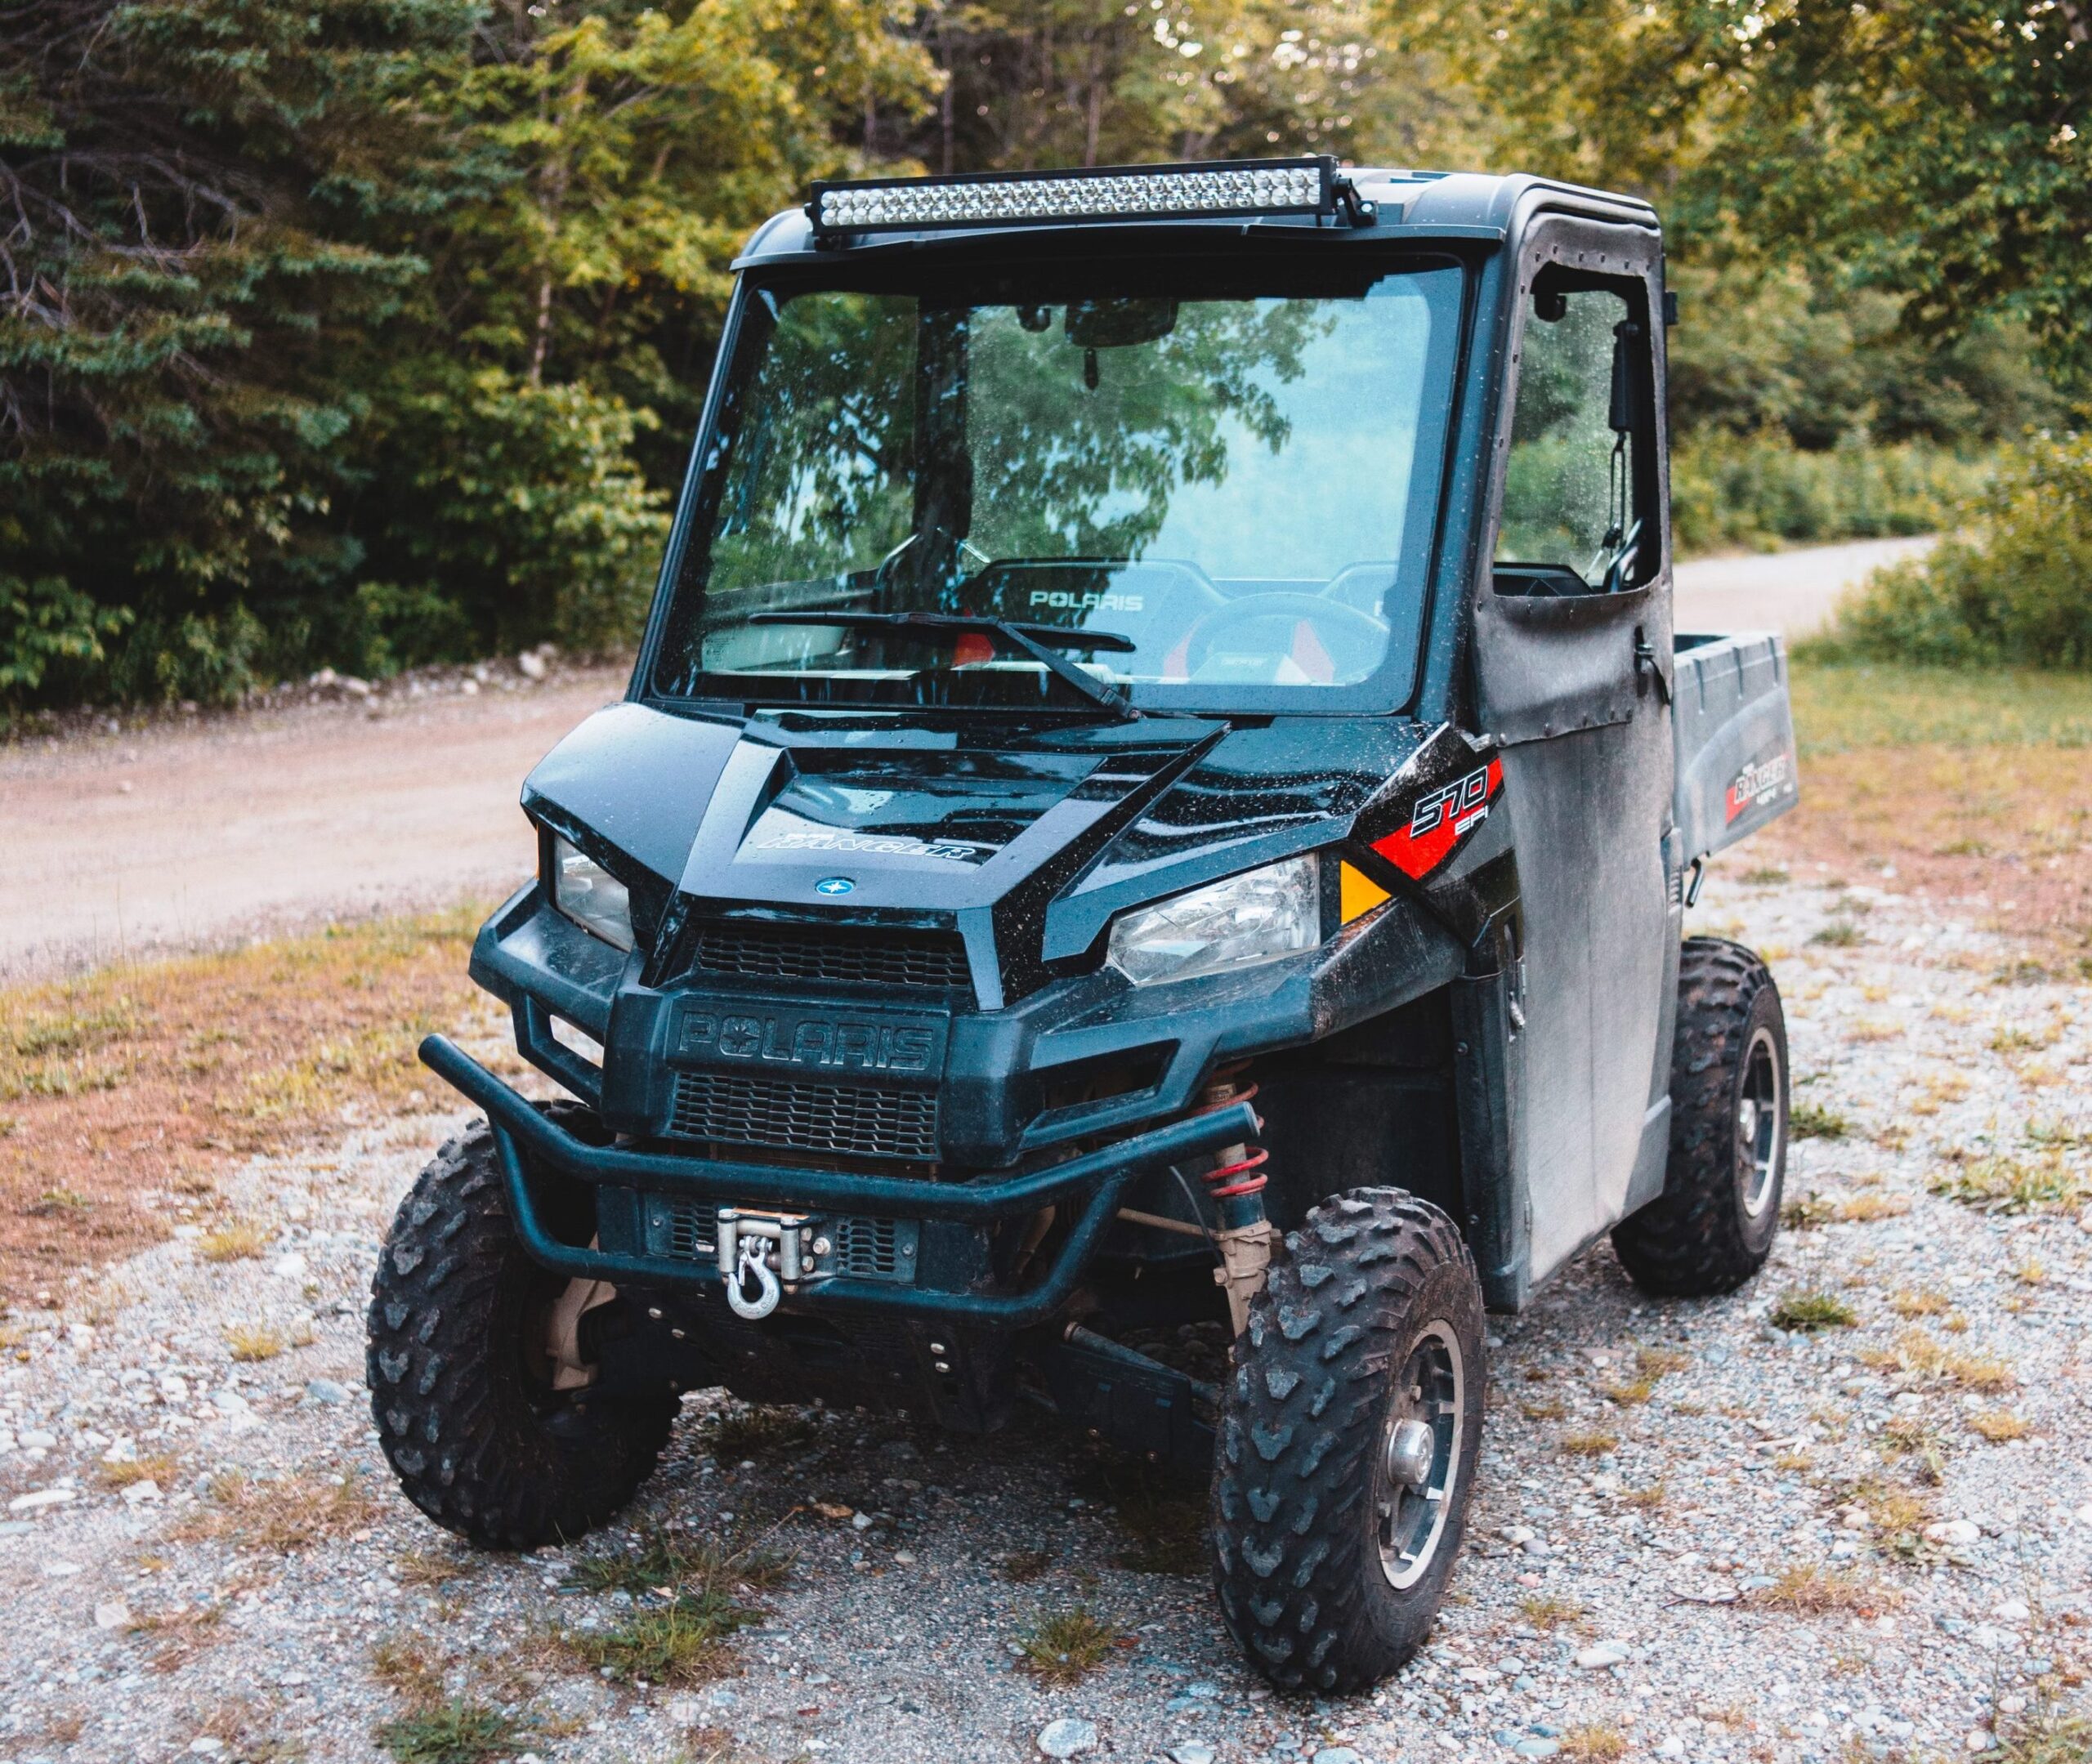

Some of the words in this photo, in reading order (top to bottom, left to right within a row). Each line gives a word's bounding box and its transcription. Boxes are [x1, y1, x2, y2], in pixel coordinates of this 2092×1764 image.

[1030, 591, 1143, 611] POLARIS
[1410, 765, 1488, 838] 570
[1455, 805, 1488, 836] EFI
[757, 835, 975, 860] RANGER
[679, 1011, 933, 1070] POLARIS
